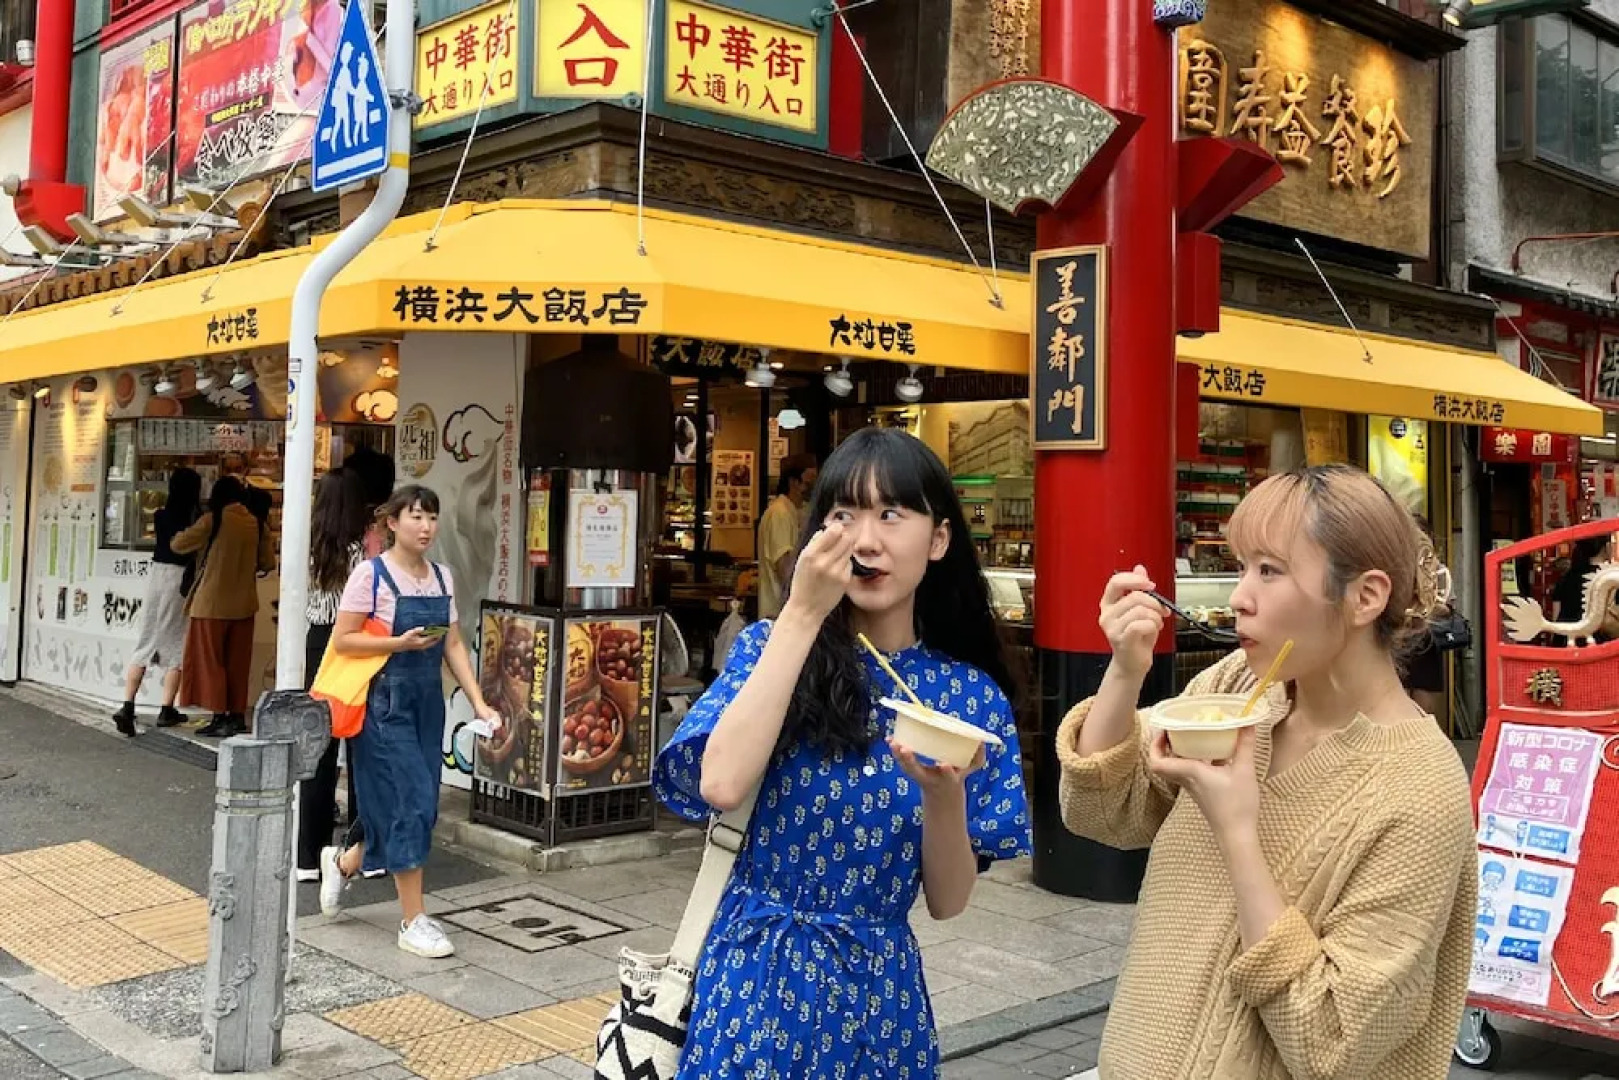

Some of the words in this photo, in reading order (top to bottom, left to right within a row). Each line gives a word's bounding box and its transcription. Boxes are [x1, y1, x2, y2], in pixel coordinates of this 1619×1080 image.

[425, 13, 516, 81] 中華街
[557, 3, 630, 87] 入口
[675, 13, 806, 87] 中華街
[423, 69, 514, 117] 大通り入口
[675, 66, 803, 116] 大通り入口
[394, 286, 648, 325] 横浜大飯店
[207, 308, 259, 348] 大粒甘栗
[829, 314, 916, 356] 大粒甘栗
[1198, 363, 1266, 395] 大飯店
[1433, 394, 1504, 423] 横浜大飯店
[1506, 731, 1591, 751] 新型コロナ
[1508, 753, 1580, 774] 感染症
[1515, 774, 1564, 795] 対策
